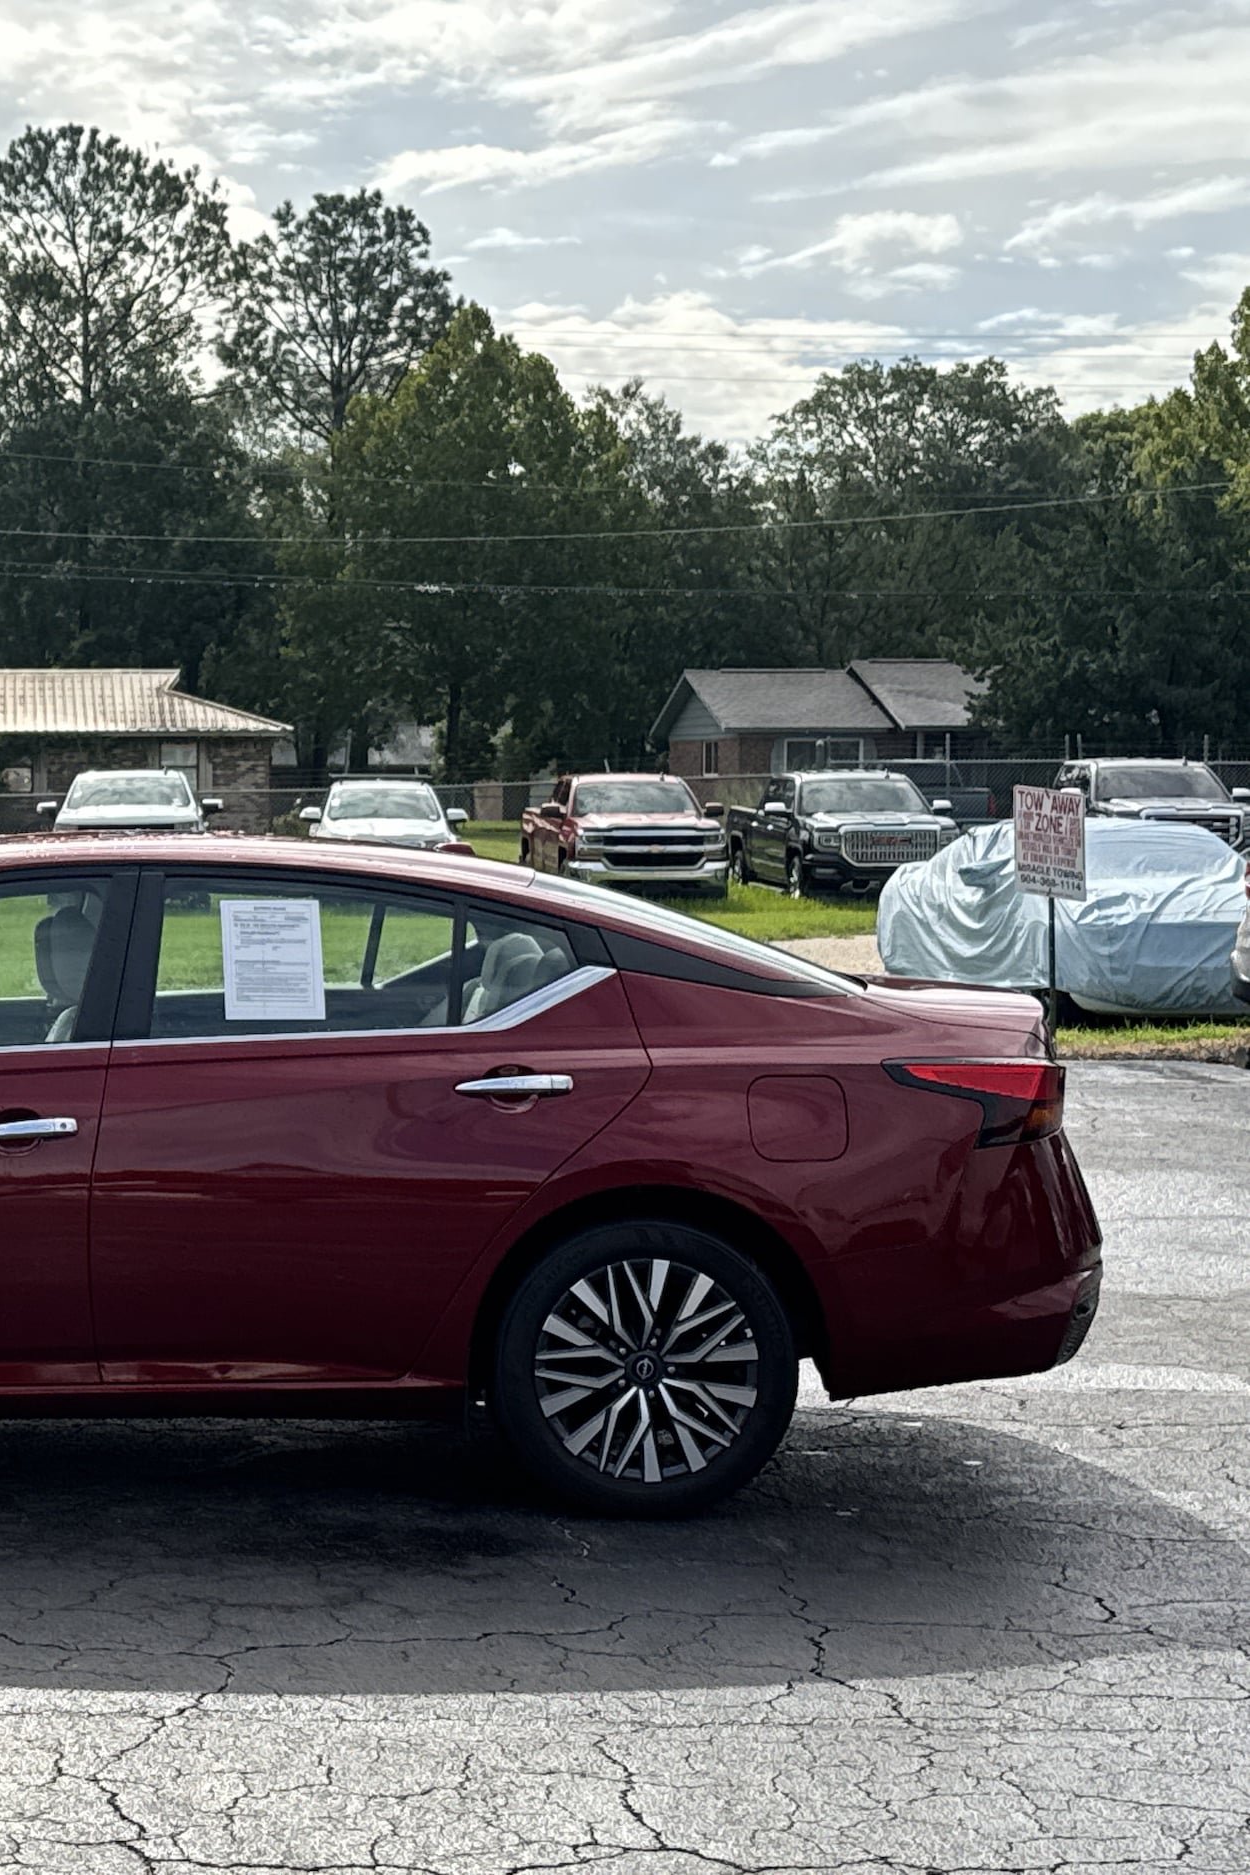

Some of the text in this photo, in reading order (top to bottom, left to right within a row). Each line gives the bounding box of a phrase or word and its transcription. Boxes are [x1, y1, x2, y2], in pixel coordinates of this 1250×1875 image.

[1018, 791, 1043, 811] TOW
[1051, 795, 1081, 816] AWAY
[1035, 813, 1063, 834] ZONE
[1018, 862, 1083, 881] MIRACLE TOWING
